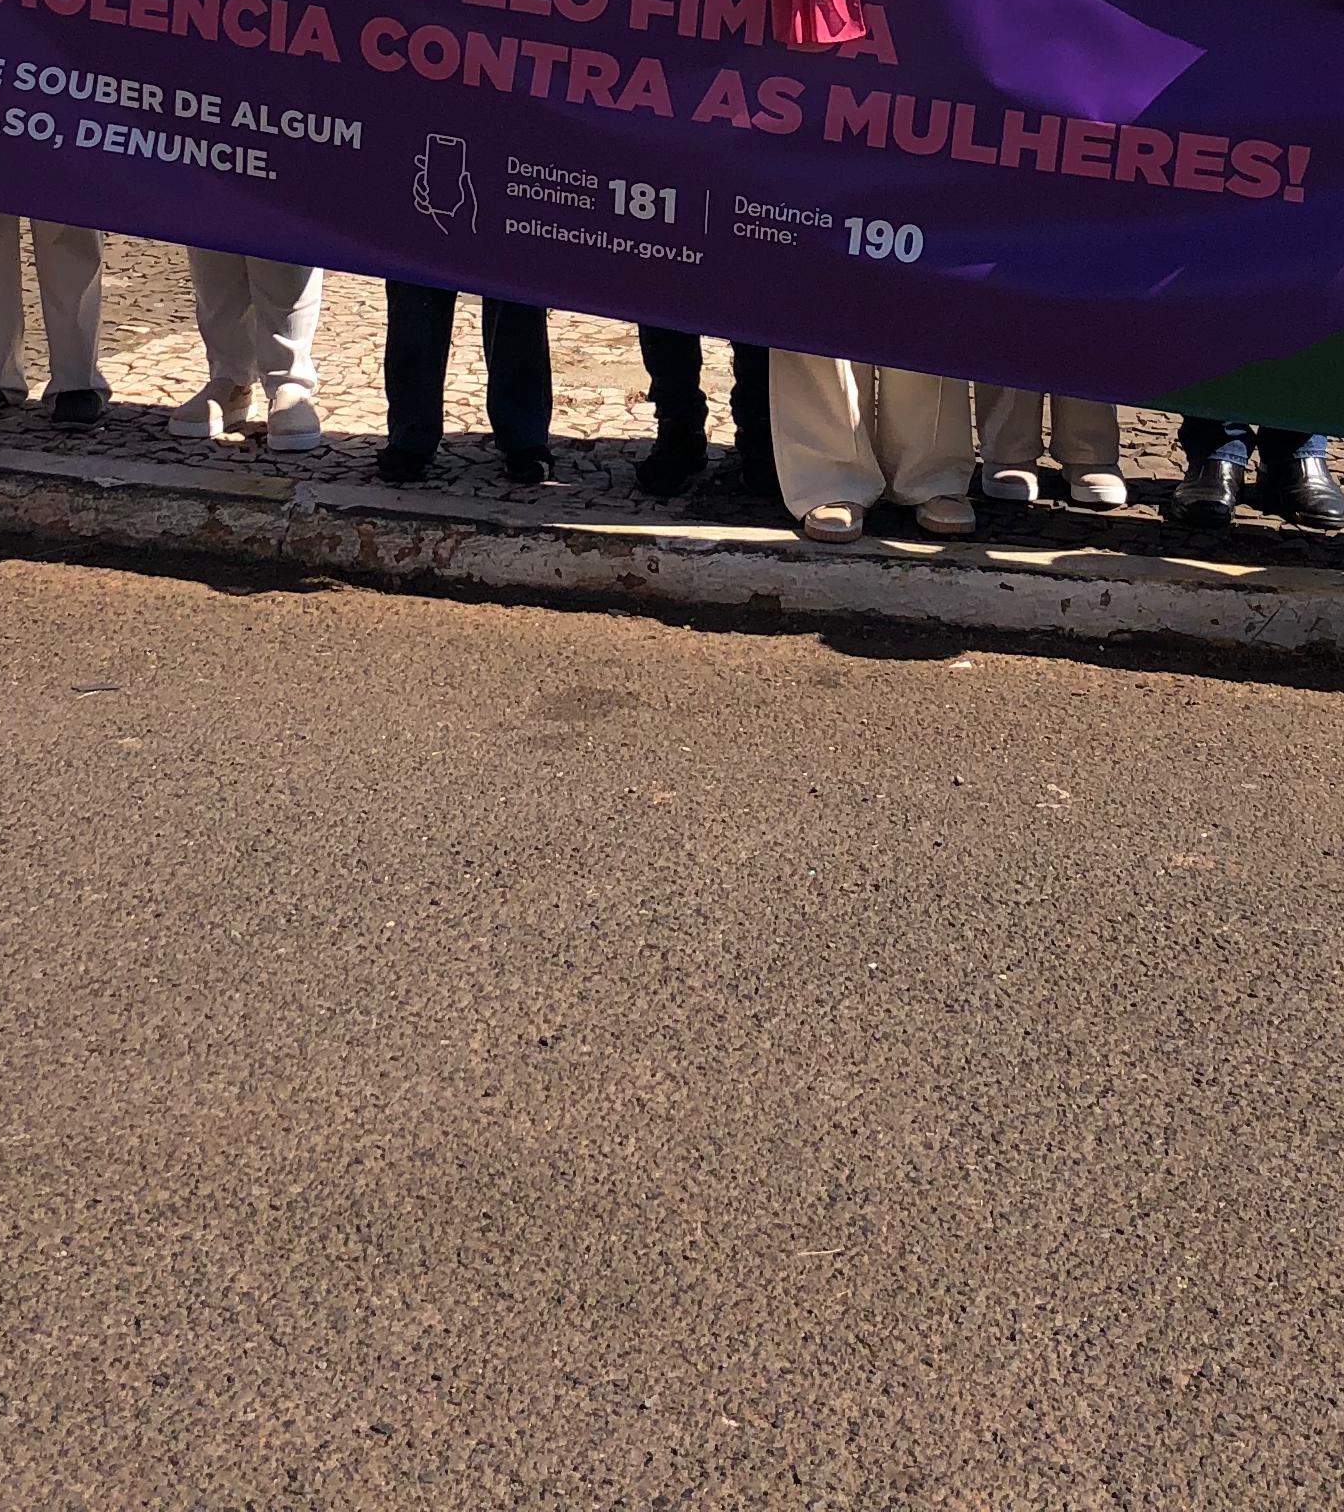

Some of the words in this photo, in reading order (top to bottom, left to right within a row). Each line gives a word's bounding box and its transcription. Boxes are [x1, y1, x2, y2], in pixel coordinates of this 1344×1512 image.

[787, 2, 899, 65] A
[13, 62, 163, 113] SOUBER
[174, 90, 221, 123] DE
[231, 102, 363, 149] ALGUM
[360, 16, 674, 118] CONTRA
[693, 69, 804, 134] AS
[823, 85, 1311, 203] MULHERES!
[76, 121, 277, 180] DENUNCIE.
[507, 156, 599, 190] Denúncia
[506, 179, 596, 211] anônima:
[608, 179, 676, 224] 181
[734, 196, 833, 229] Denúncia
[505, 216, 704, 265] policiacivil.pr.gov.br
[733, 219, 798, 246] crime:
[844, 217, 924, 263] 190
